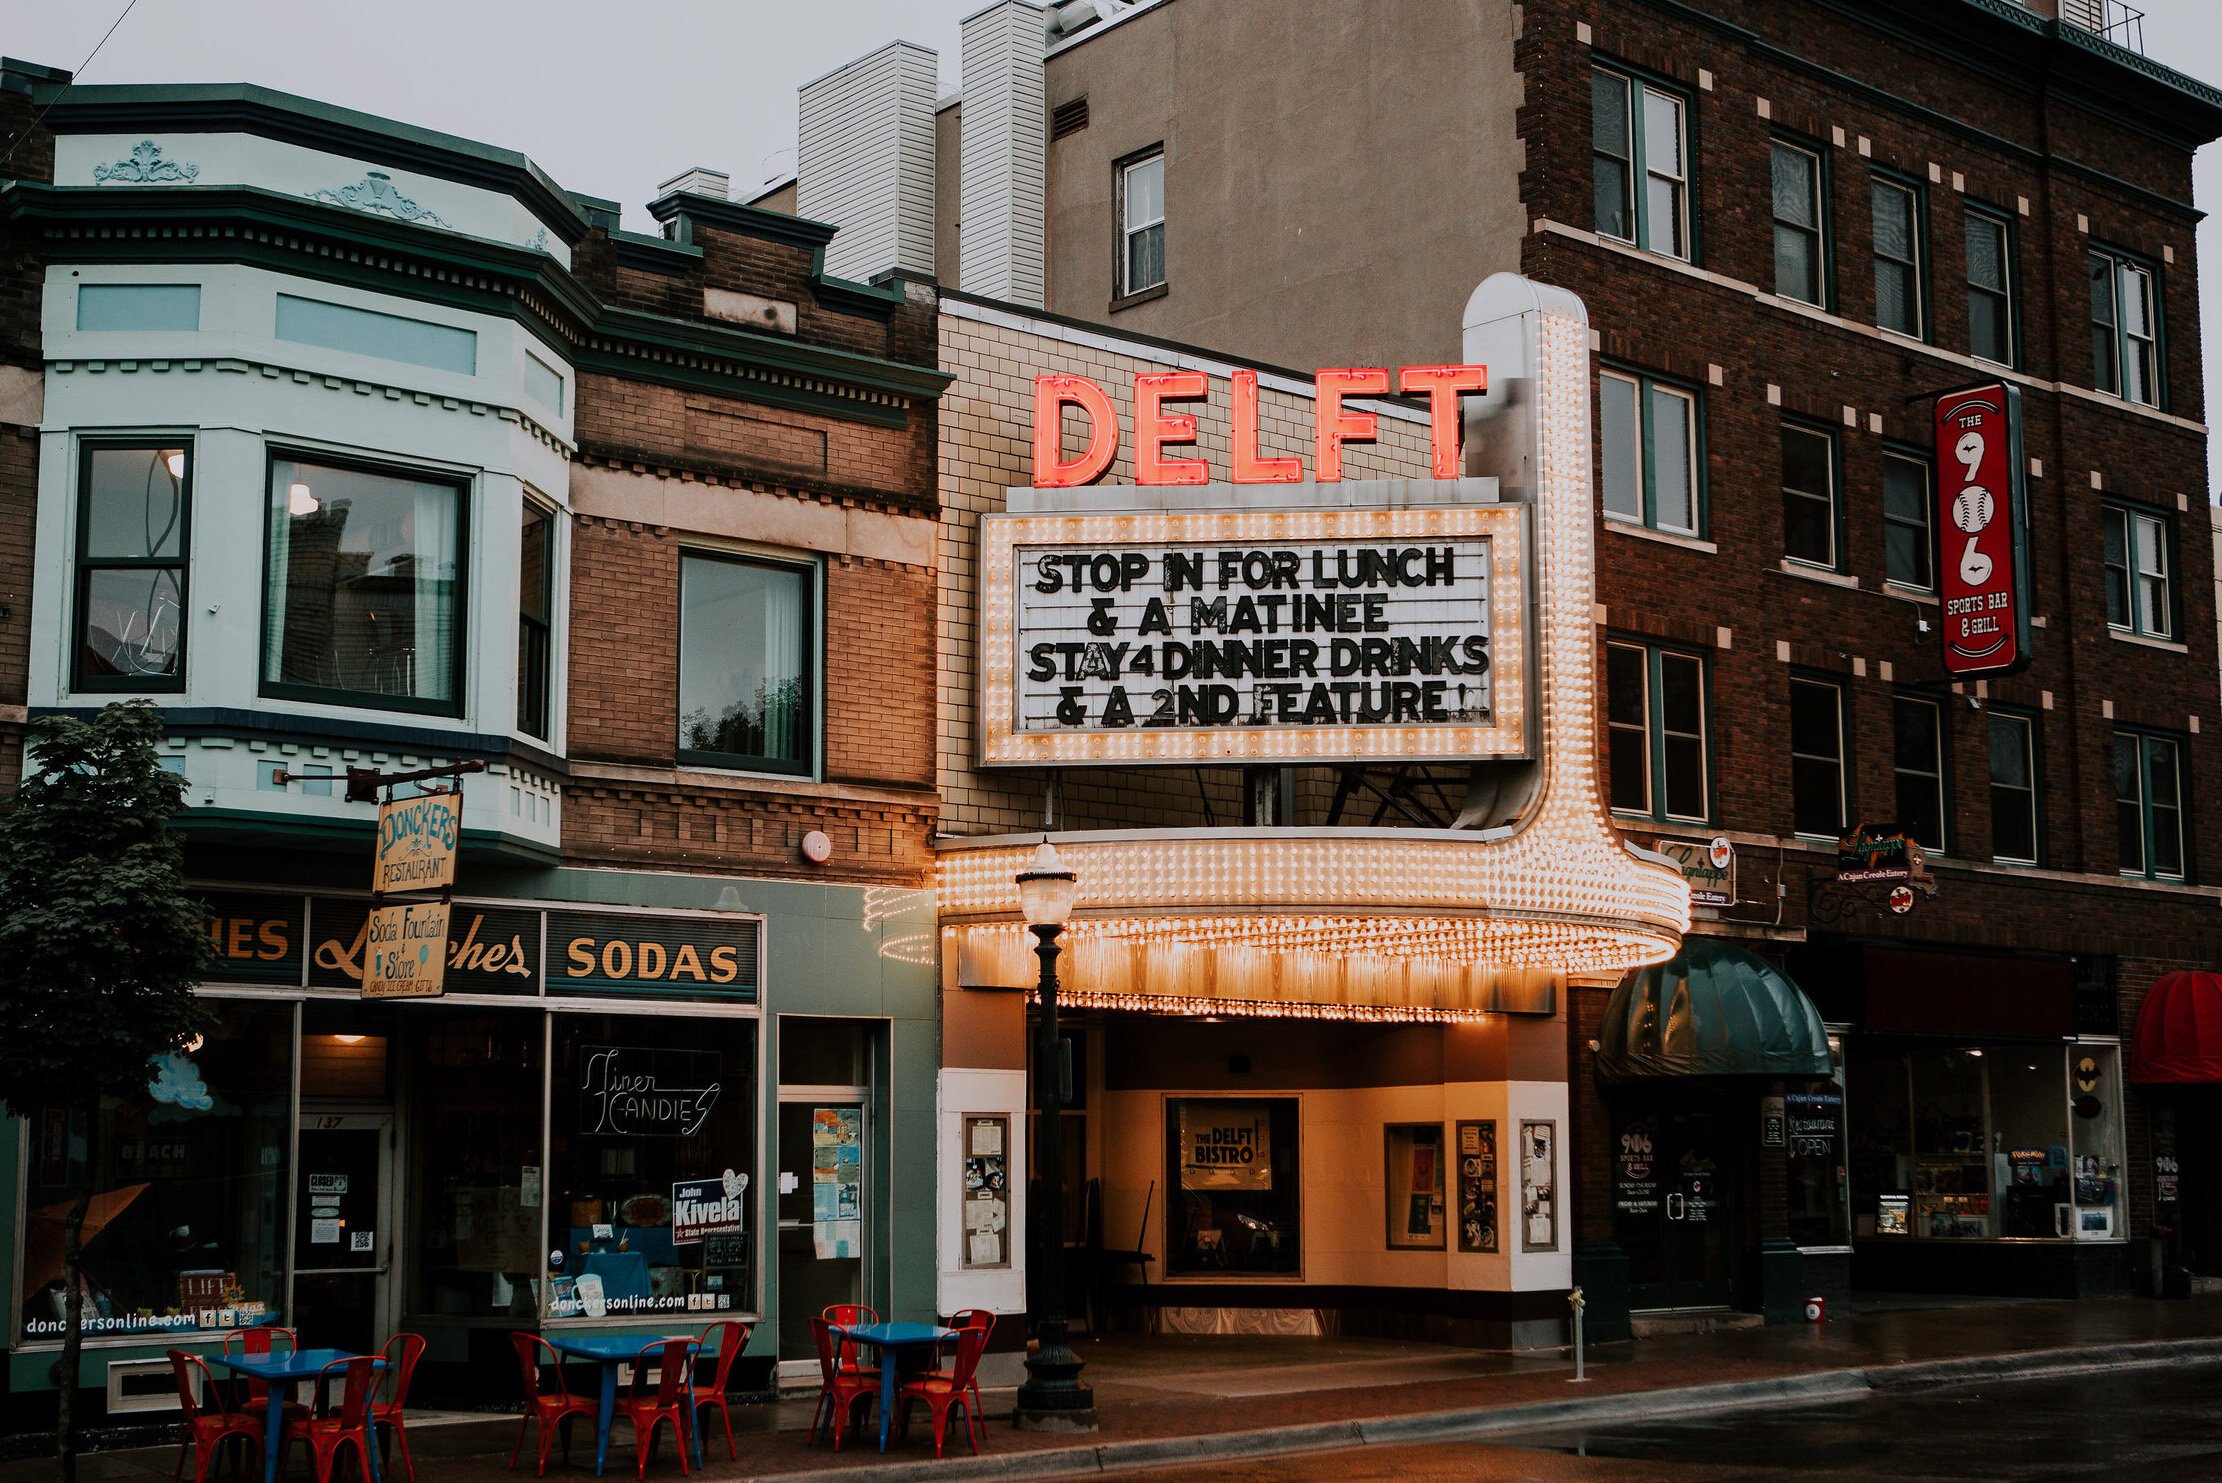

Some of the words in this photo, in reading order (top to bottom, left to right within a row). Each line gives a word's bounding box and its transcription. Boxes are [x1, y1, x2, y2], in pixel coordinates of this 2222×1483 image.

[1034, 365, 1487, 489] DELFT
[1958, 414, 1983, 428] THE
[1035, 554, 1150, 593] STOP
[1163, 552, 1203, 591] IN
[1218, 550, 1301, 591] FOR
[1313, 547, 1455, 590] LUNCH
[1087, 597, 1118, 637] &
[1138, 597, 1172, 636] A
[1190, 593, 1389, 636] MATINEE
[1947, 595, 1984, 615] SPORTS
[1988, 592, 2009, 610] BAR
[1961, 618, 1970, 638] &
[1971, 616, 1999, 634] GRILL
[1028, 642, 1130, 682] STAY
[1130, 644, 1155, 678] 4
[1162, 637, 1319, 681] DINNER
[1330, 635, 1489, 678] DRINKS
[1056, 686, 1088, 727] &
[1101, 686, 1135, 725] A
[1142, 684, 1240, 727] 2ND
[380, 800, 458, 861] DONCKERS
[383, 858, 446, 886] RESTAURANT
[1886, 869, 1909, 879] Eatery
[370, 911, 398, 943] Soda
[403, 906, 446, 940] Fountain
[386, 951, 415, 980] Store
[567, 937, 738, 983] SODAS
[609, 1082, 721, 1136] CANDIES
[317, 1117, 343, 1128] 137
[1195, 1133, 1210, 1144] THE
[1211, 1127, 1252, 1145] DELFT
[1621, 1133, 1653, 1154] 906
[1799, 1139, 1832, 1156] OPEN
[1194, 1145, 1253, 1164] BISTRO
[311, 1176, 334, 1187] CLOSED
[679, 1188, 702, 1199] John
[675, 1196, 740, 1227] Kivela
[685, 1228, 700, 1237] State
[26, 1311, 196, 1334] doncersonline.com
